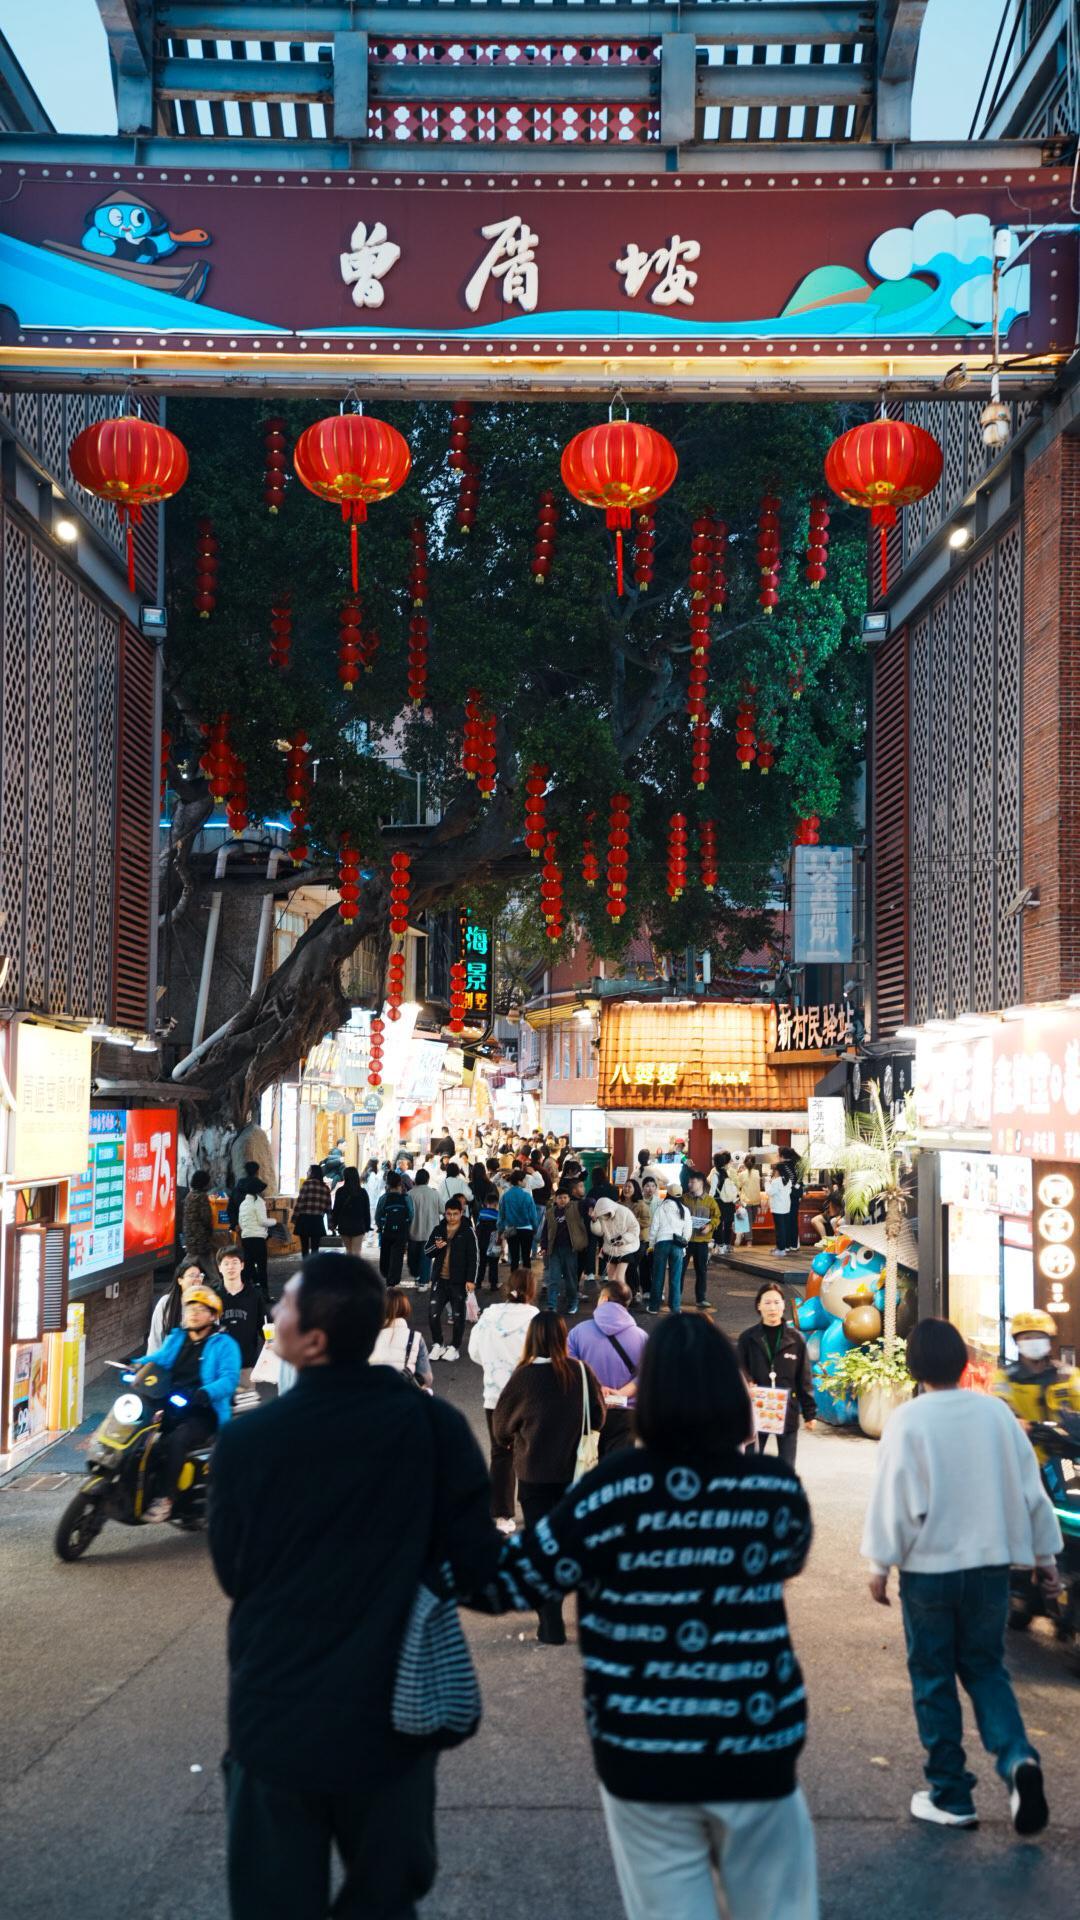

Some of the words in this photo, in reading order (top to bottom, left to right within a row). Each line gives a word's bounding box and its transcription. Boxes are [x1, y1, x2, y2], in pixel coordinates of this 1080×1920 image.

[340, 216, 701, 313] 曾厝垵
[466, 926, 488, 991] 海景
[778, 1001, 855, 1050] 新村民驿站
[609, 1061, 678, 1086] 八婆婆
[150, 1131, 172, 1211] 75
[636, 1509, 769, 1532] PEACEBIRD
[643, 1660, 770, 1682] PEACEBIRD
[606, 1693, 741, 1717] PEACEBIRD
